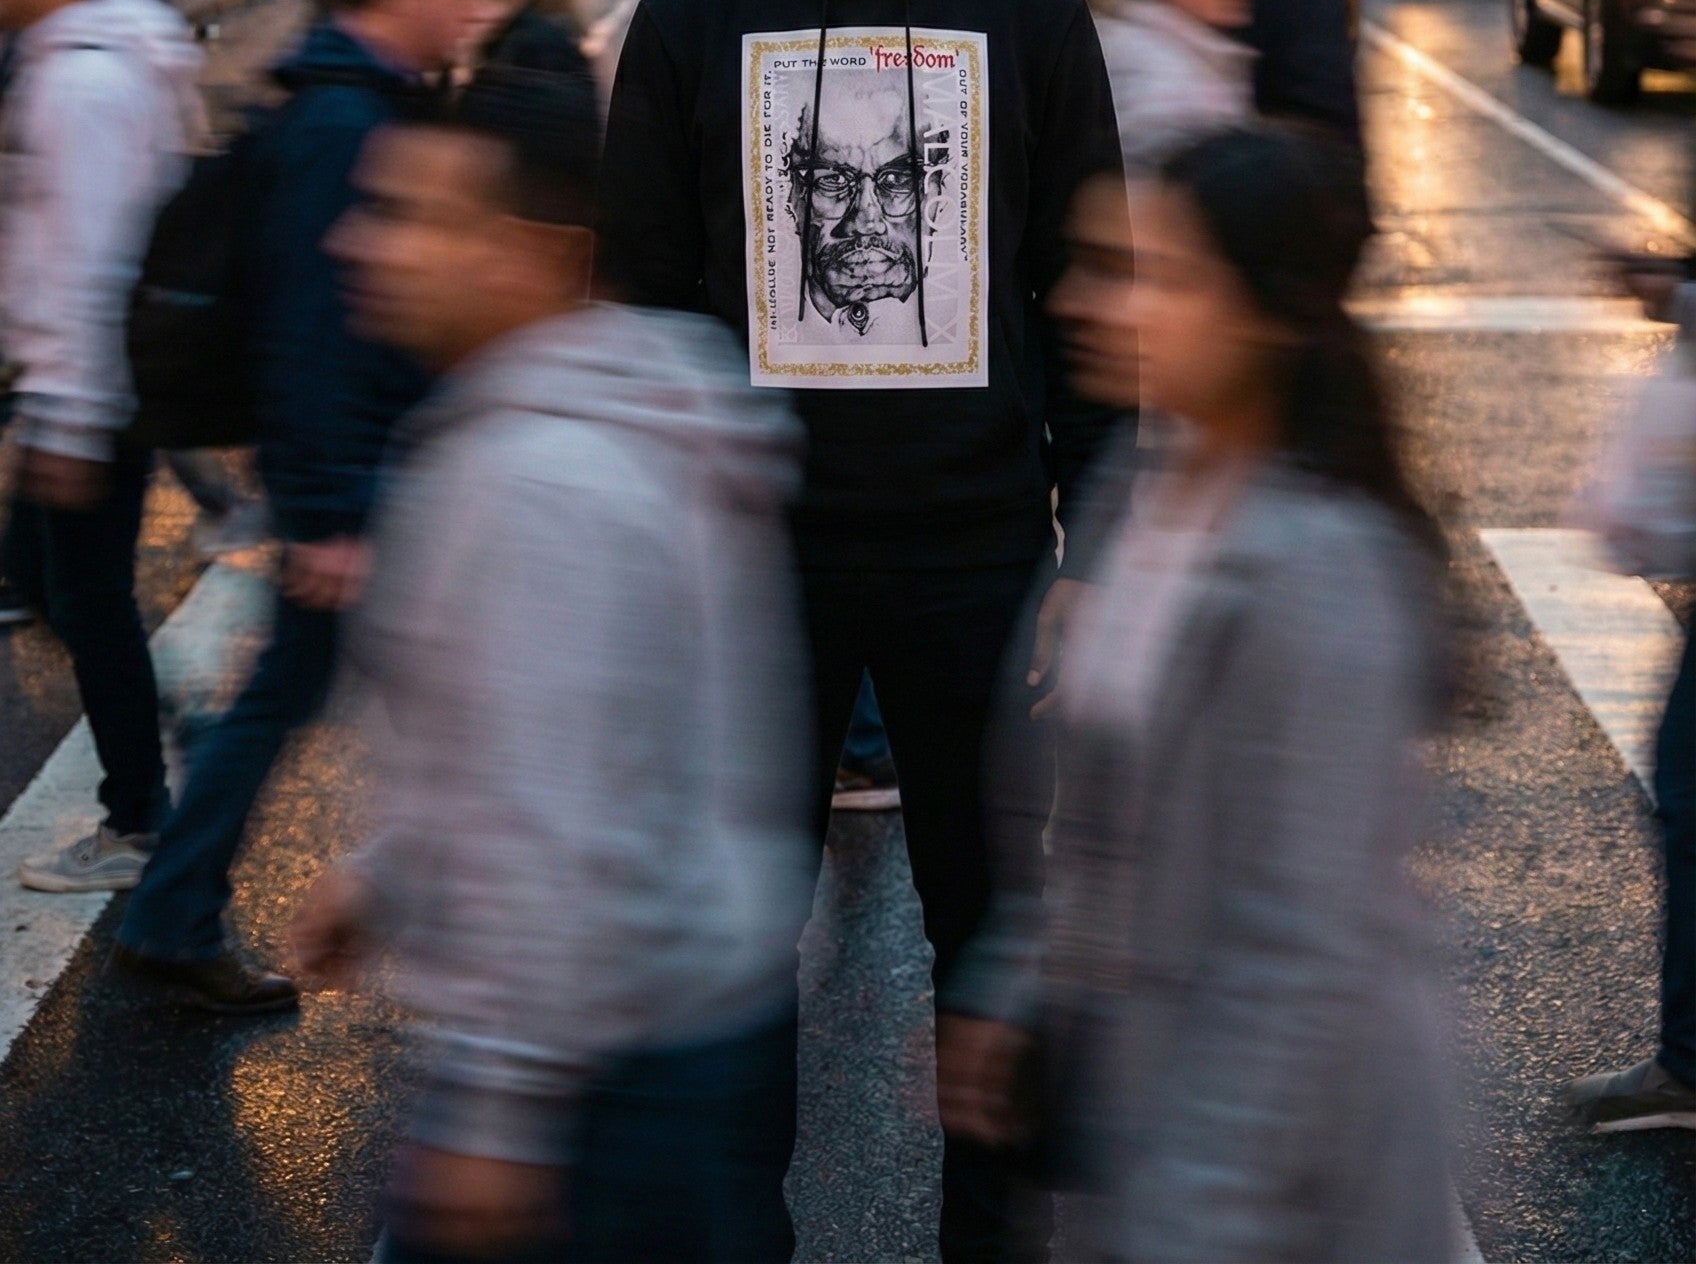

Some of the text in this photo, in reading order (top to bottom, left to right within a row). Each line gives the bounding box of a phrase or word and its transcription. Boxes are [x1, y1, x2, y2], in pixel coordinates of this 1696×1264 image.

[774, 60, 797, 68] PUT
[830, 57, 866, 66] WORD
[960, 100, 968, 118] OF
[763, 124, 772, 148] DIE
[764, 153, 773, 171] TO
[924, 69, 958, 344] MALCOLM X
